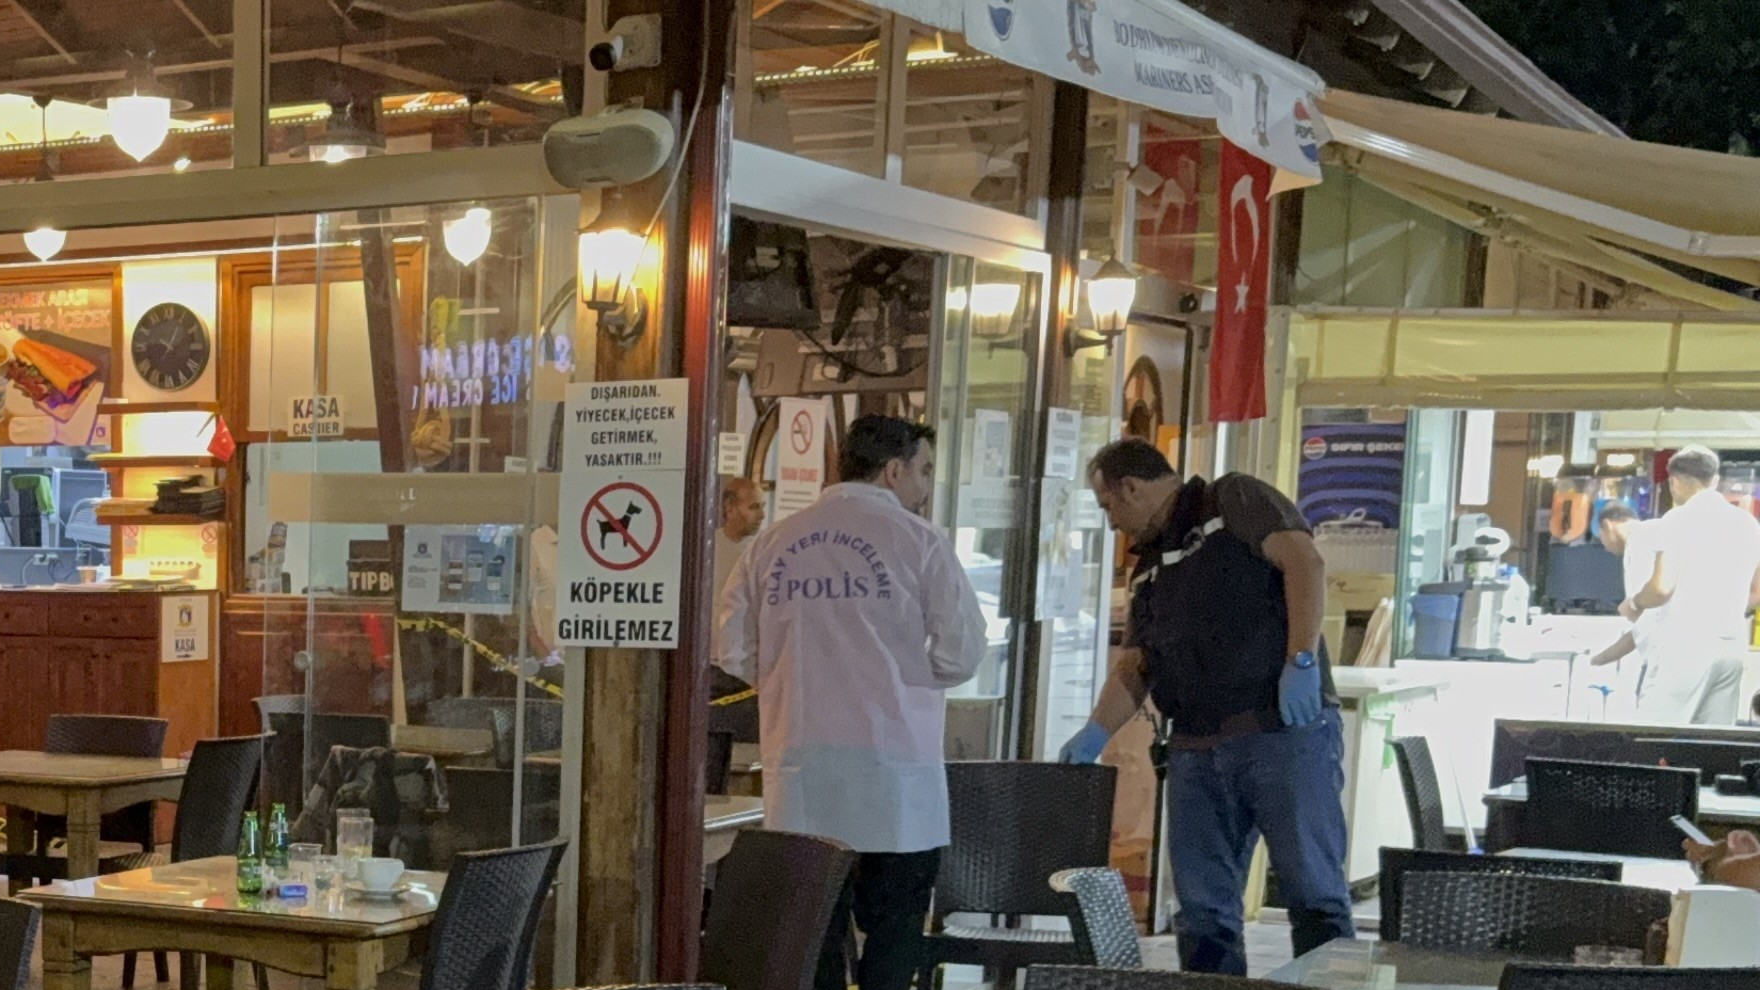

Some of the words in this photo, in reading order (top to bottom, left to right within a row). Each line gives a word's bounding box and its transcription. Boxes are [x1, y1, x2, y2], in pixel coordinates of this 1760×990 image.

[293, 397, 340, 419] KASA
[349, 571, 378, 591] TIP
[570, 576, 664, 604] KÖPEKLE
[767, 556, 786, 606] OLAY
[787, 570, 869, 600] POLİS
[558, 613, 673, 642] GİRİLEMEZ
